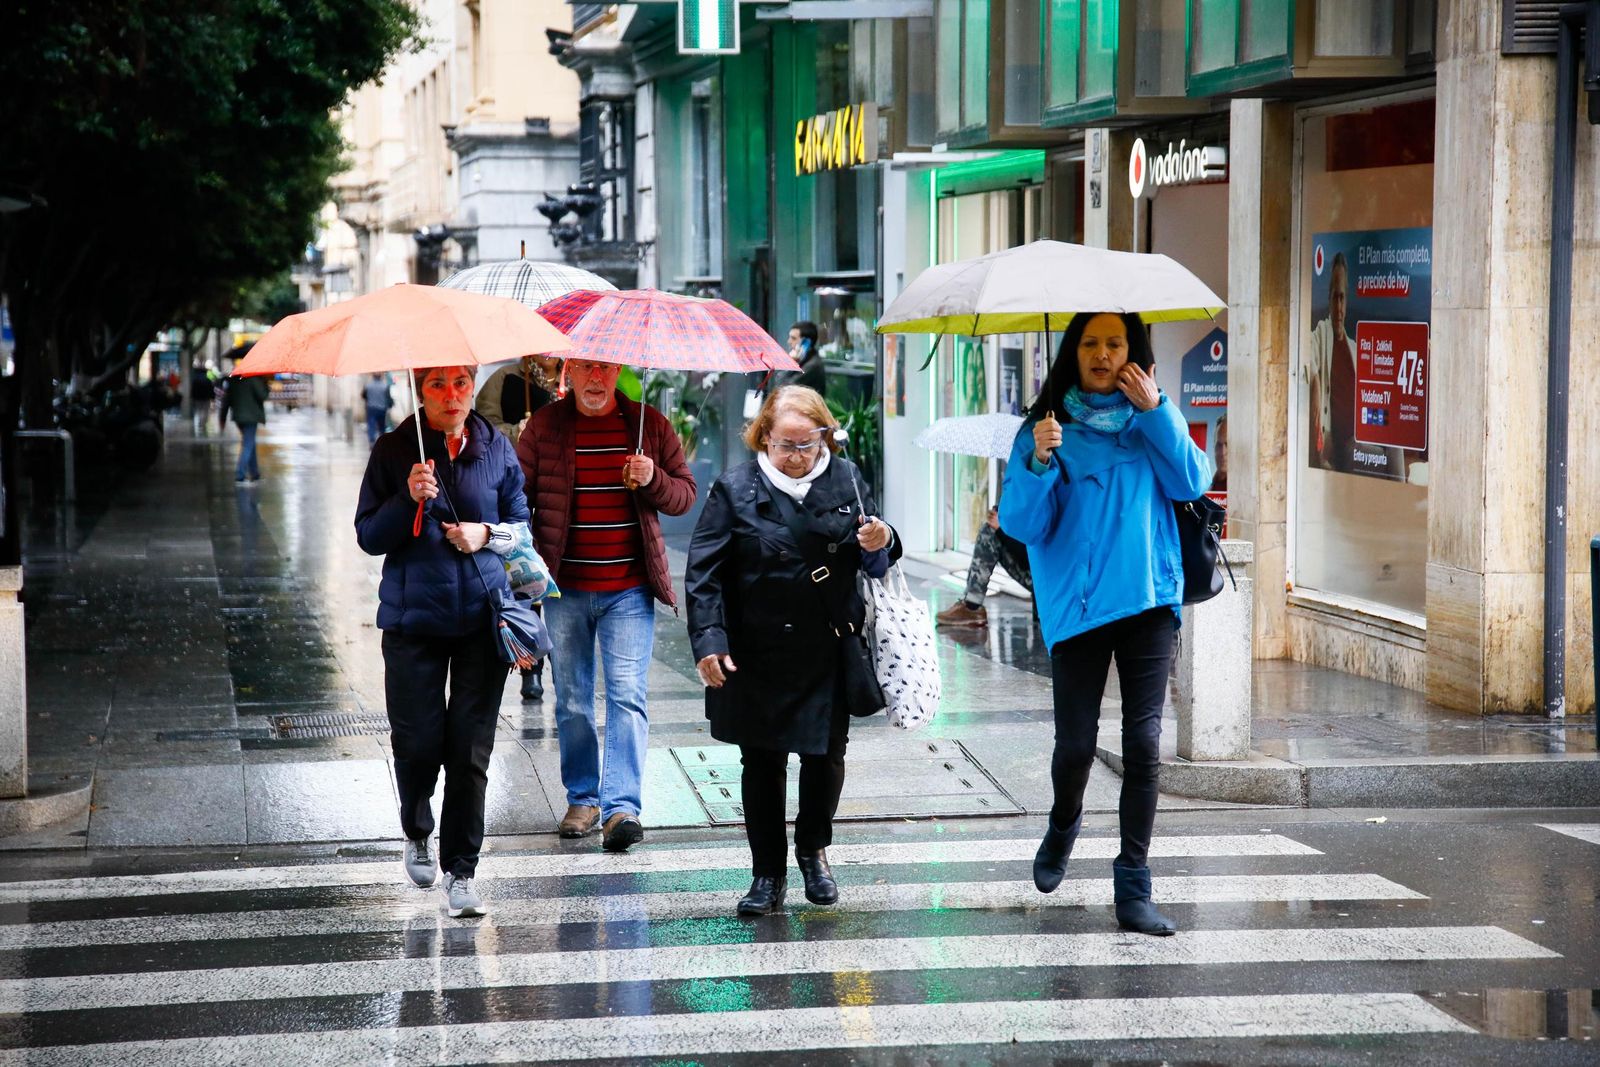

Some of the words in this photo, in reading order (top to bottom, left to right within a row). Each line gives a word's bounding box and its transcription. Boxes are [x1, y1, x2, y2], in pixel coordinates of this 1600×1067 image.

[1149, 139, 1209, 186] vodafone
[1359, 246, 1365, 264] El
[1366, 246, 1380, 263] Plan
[1381, 244, 1395, 263] más
[1396, 244, 1430, 267] completo,
[1358, 275, 1362, 289] a
[1363, 271, 1386, 293] precios
[1387, 271, 1396, 289] de
[1397, 271, 1410, 293] hoy
[1184, 383, 1189, 393] El
[1191, 383, 1204, 392] Plan
[1204, 382, 1217, 392] más
[1361, 389, 1383, 404] Vodafone
[1384, 391, 1391, 404] TV
[1196, 395, 1217, 405] precios
[1218, 394, 1226, 404] de
[1354, 448, 1365, 461] Entra
[1368, 452, 1387, 467] pregunta
